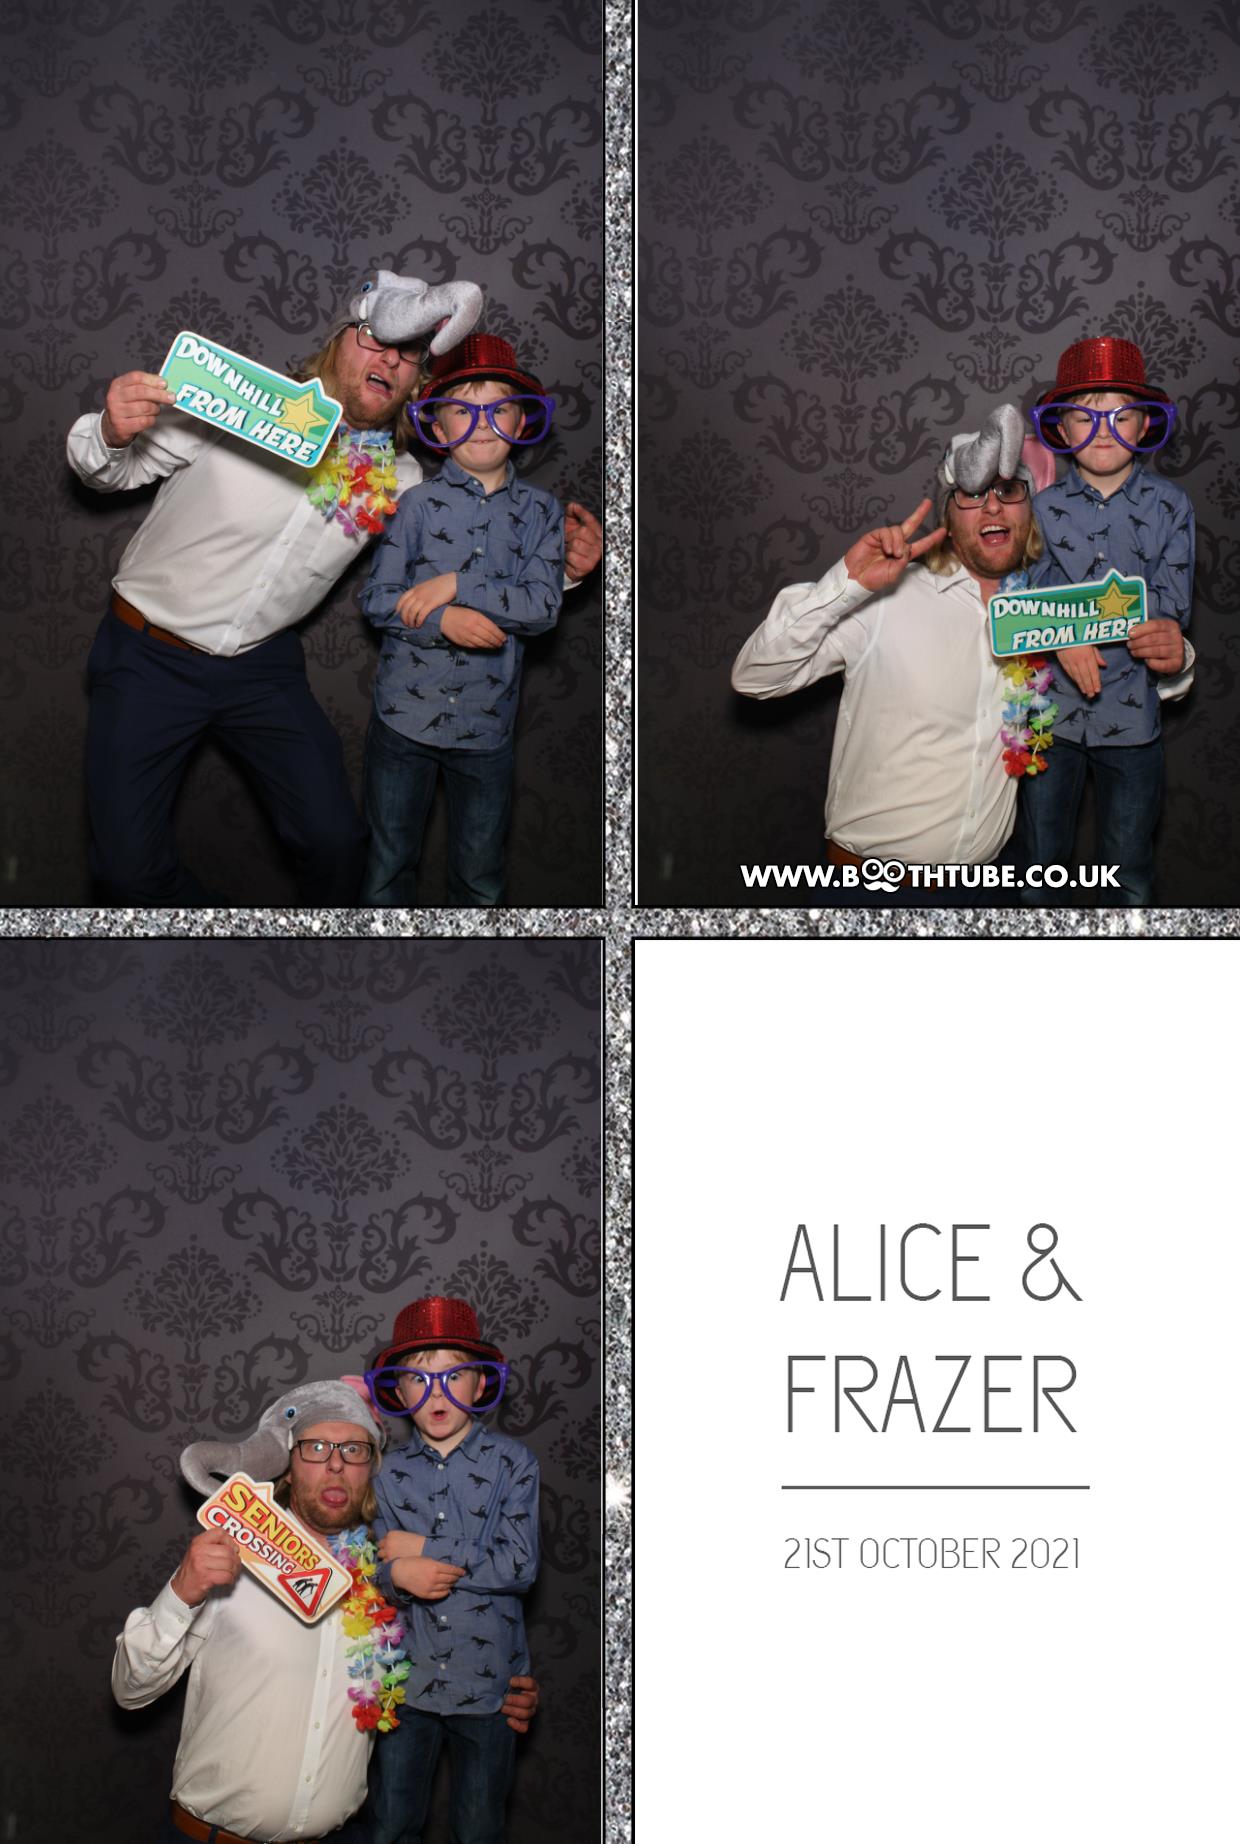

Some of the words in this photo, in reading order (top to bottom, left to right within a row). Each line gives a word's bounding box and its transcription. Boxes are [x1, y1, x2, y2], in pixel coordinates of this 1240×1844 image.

[176, 337, 285, 417] DOWNHILL
[176, 384, 247, 430] FROM
[249, 420, 319, 462] HERE
[993, 598, 1100, 619] DOWNHILL
[1012, 624, 1075, 650] FROM
[207, 1507, 296, 1574] CROSSING
[220, 1482, 320, 1571] SENIORS
